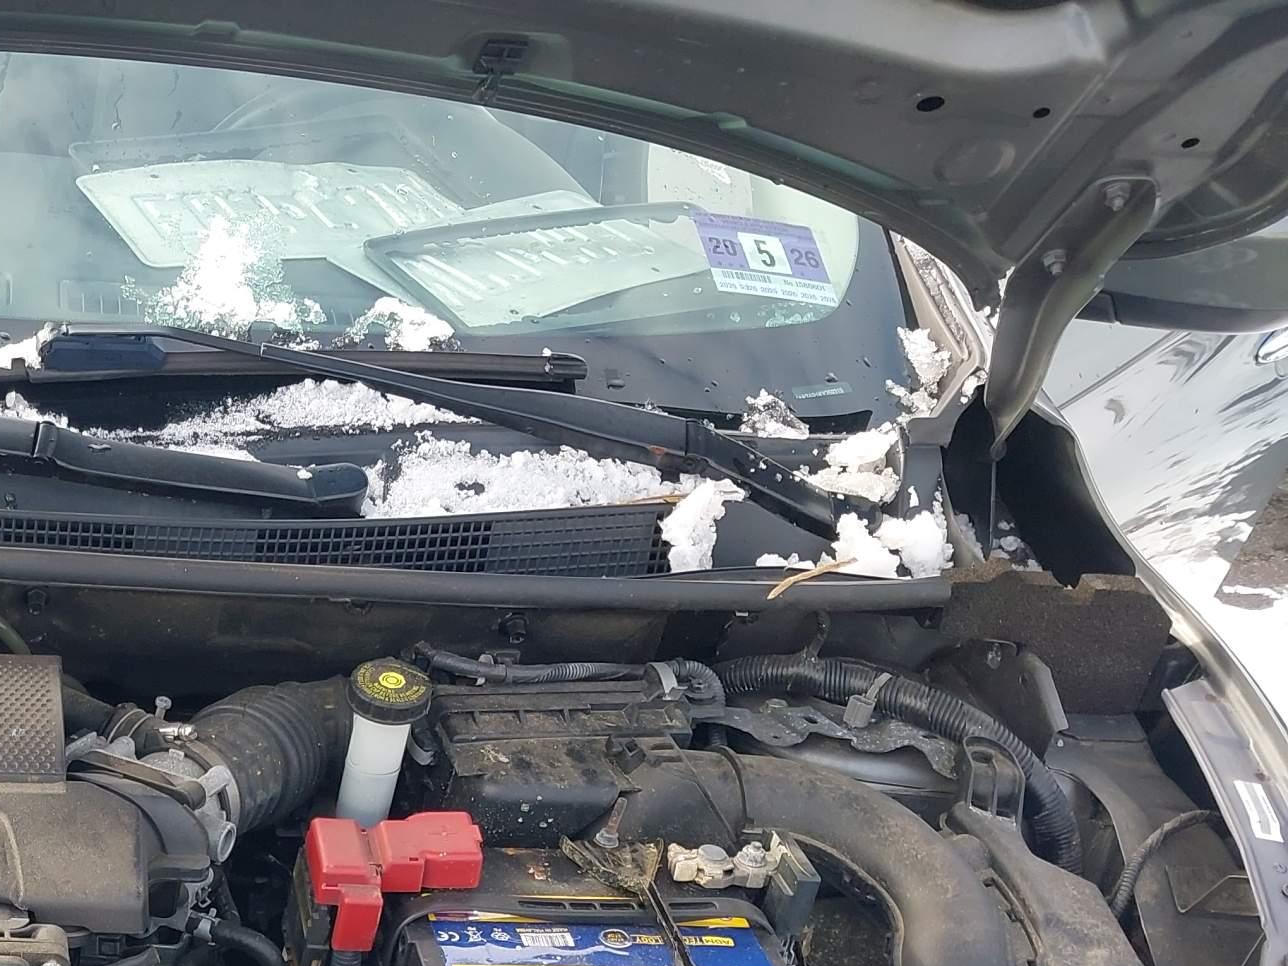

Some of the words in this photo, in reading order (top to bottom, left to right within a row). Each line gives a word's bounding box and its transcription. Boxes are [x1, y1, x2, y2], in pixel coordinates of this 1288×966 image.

[709, 237, 737, 256] 20
[753, 239, 776, 268] 5
[790, 248, 819, 269] 26
